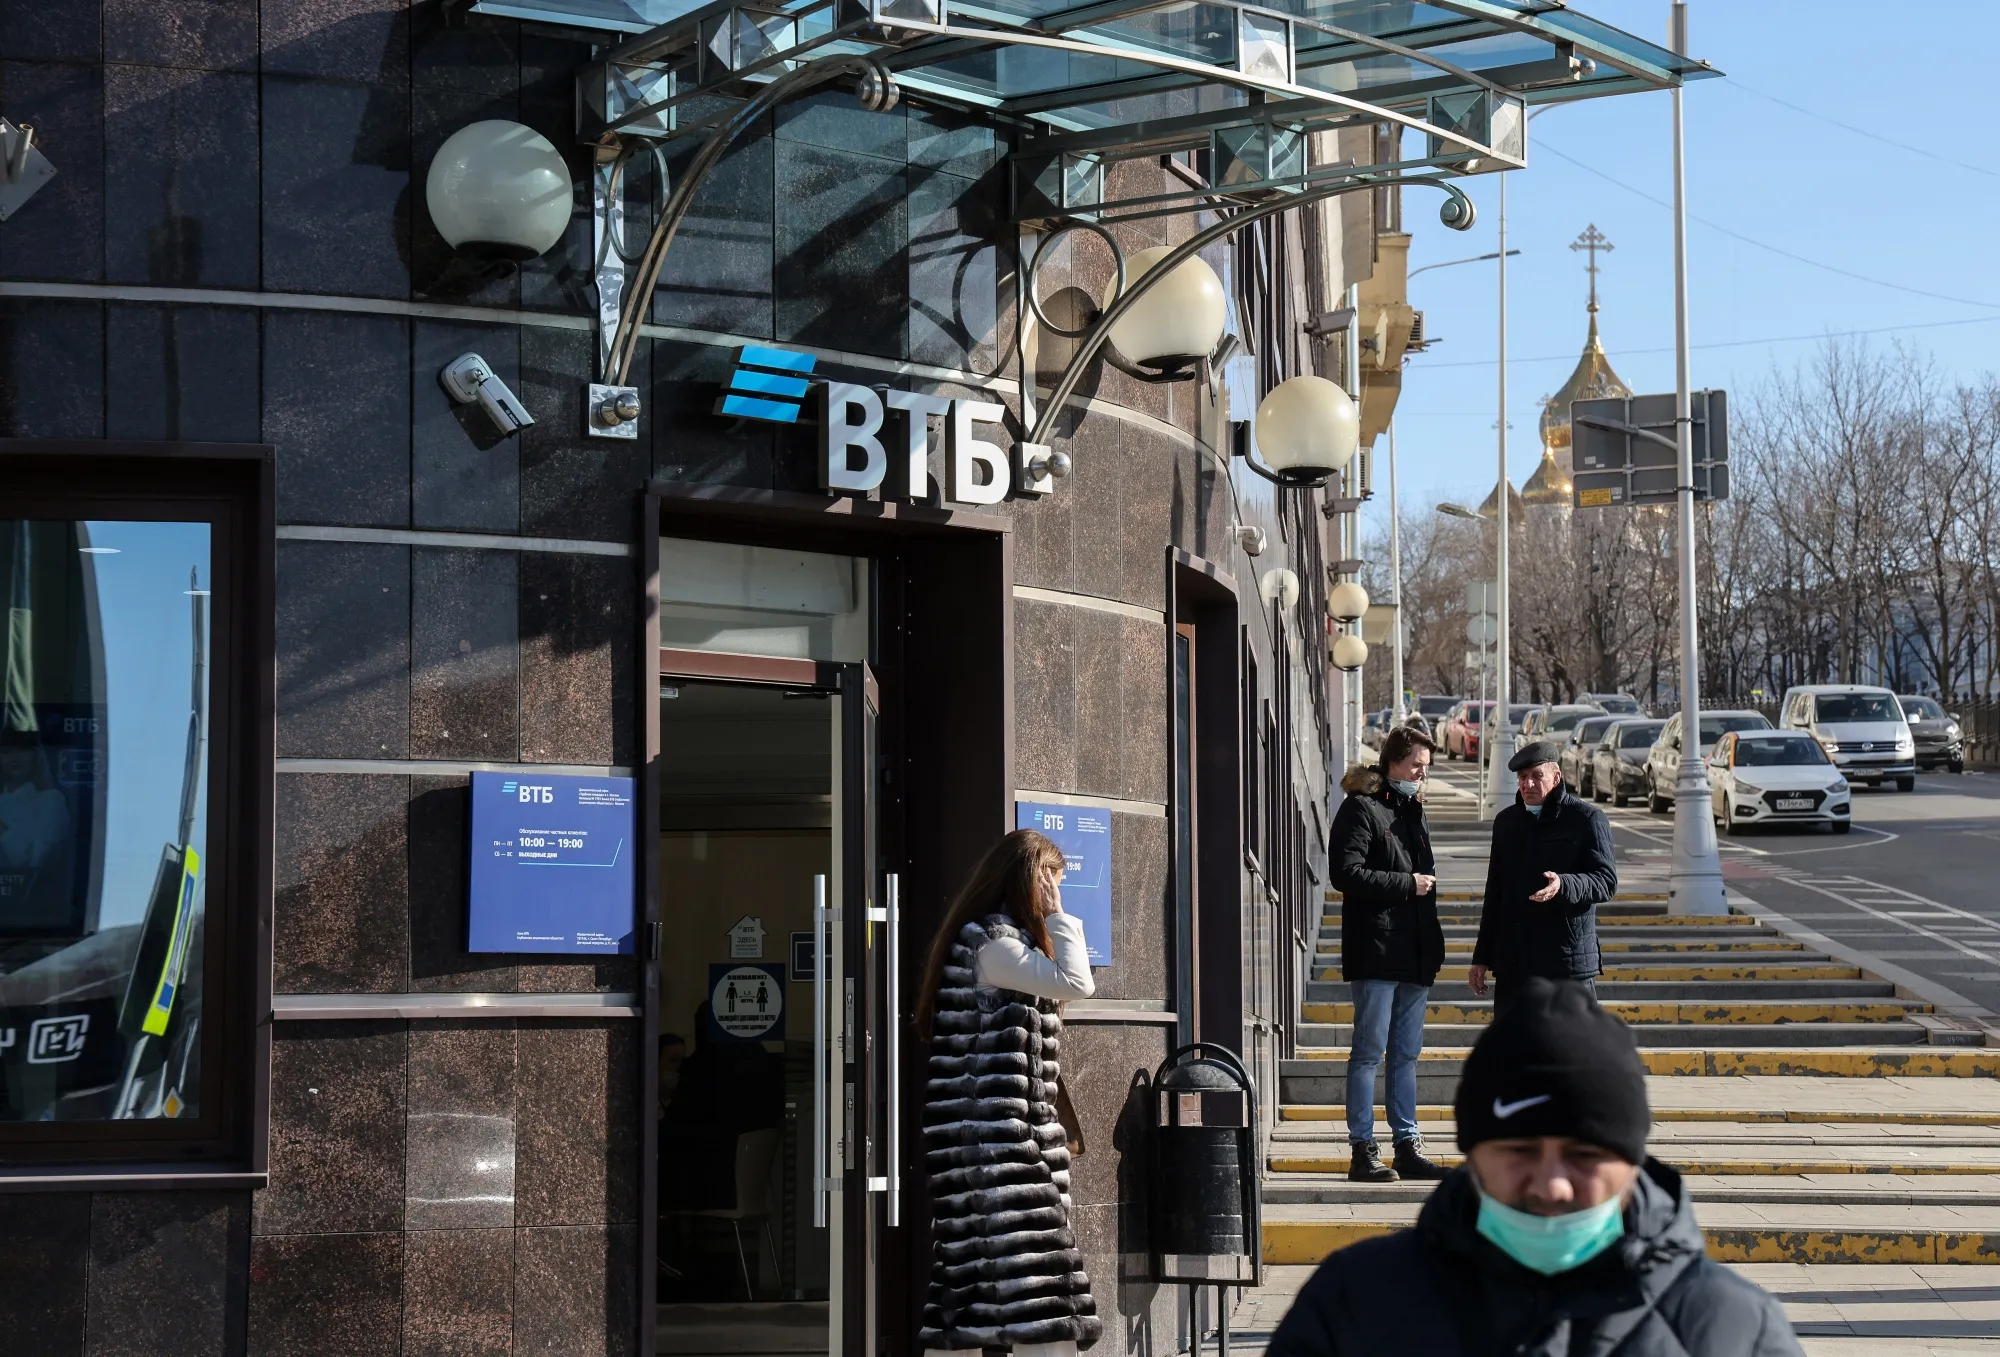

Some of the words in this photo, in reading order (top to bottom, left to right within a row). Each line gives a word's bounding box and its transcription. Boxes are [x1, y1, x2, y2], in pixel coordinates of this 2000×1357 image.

[824, 381, 1011, 505] ВТБ
[63, 717, 99, 733] ВТБ
[519, 786, 553, 804] ВТБ
[1043, 814, 1064, 831] ВТБ
[519, 837, 545, 847] 10:00
[557, 838, 583, 848] 19:00
[1066, 862, 1082, 871] 19:00
[737, 936, 757, 944] ЗДЕСЬ
